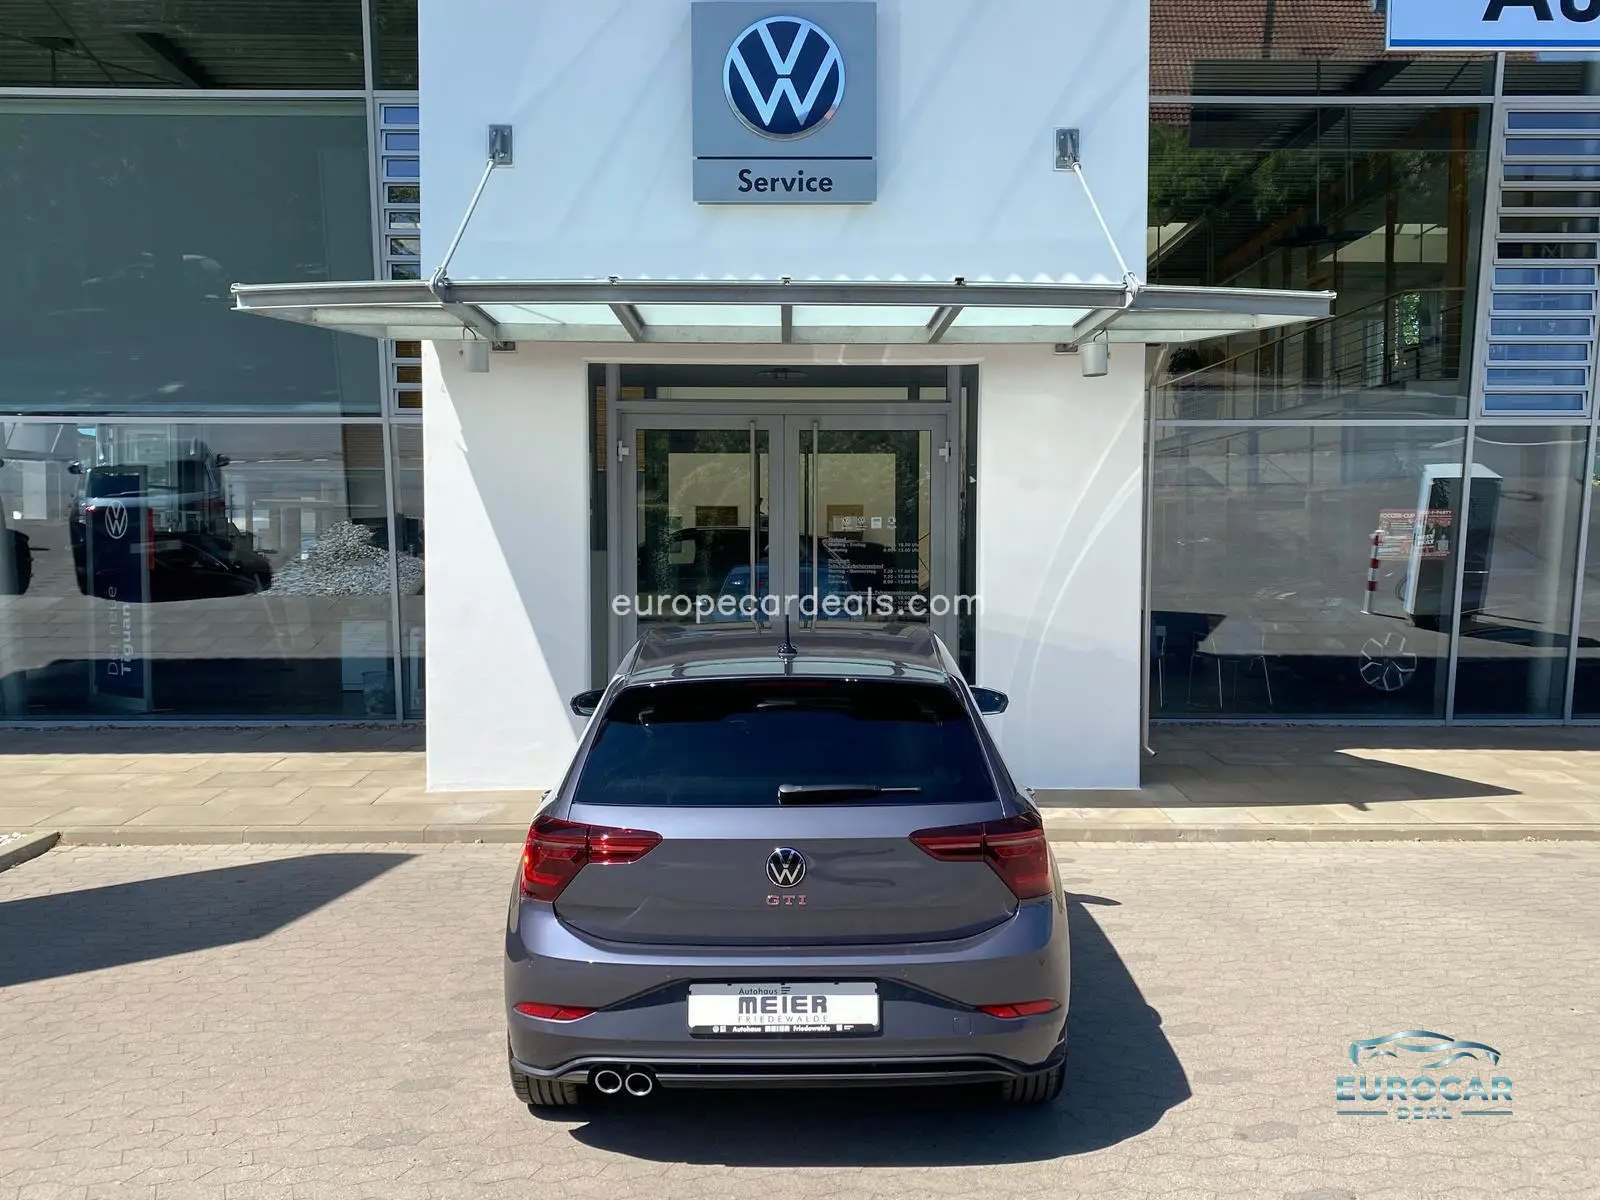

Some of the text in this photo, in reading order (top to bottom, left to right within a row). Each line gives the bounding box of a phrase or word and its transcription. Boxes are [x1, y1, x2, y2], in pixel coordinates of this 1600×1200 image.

[738, 168, 833, 192] Service
[766, 894, 807, 906] GTI
[738, 987, 778, 995] Autohaus
[738, 995, 828, 1014] MEIER
